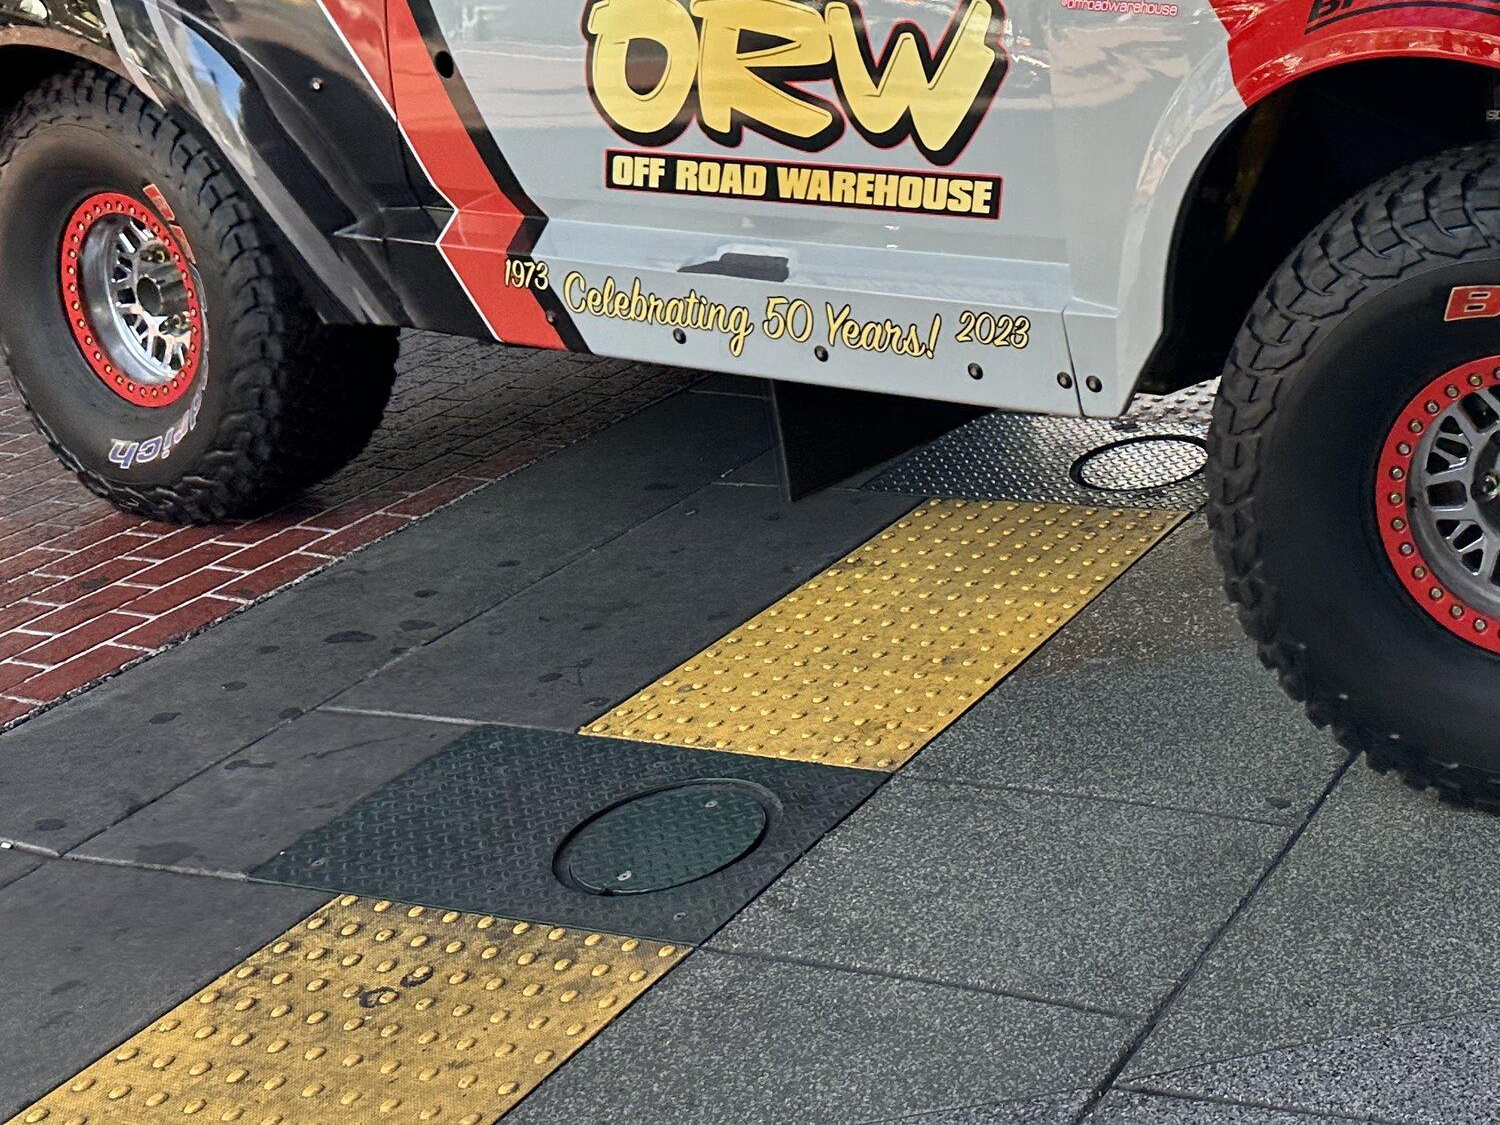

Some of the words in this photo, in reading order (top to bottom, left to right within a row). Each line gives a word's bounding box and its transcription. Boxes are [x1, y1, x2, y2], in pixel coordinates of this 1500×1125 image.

[612, 154, 666, 189] OFF
[675, 159, 767, 199] ROAD
[777, 165, 993, 215] WAREHOUSE
[504, 258, 550, 291] 1973
[562, 270, 757, 358] Celebrating
[762, 295, 814, 343] 50
[824, 301, 943, 360] Years!
[954, 309, 1031, 350] 2023
